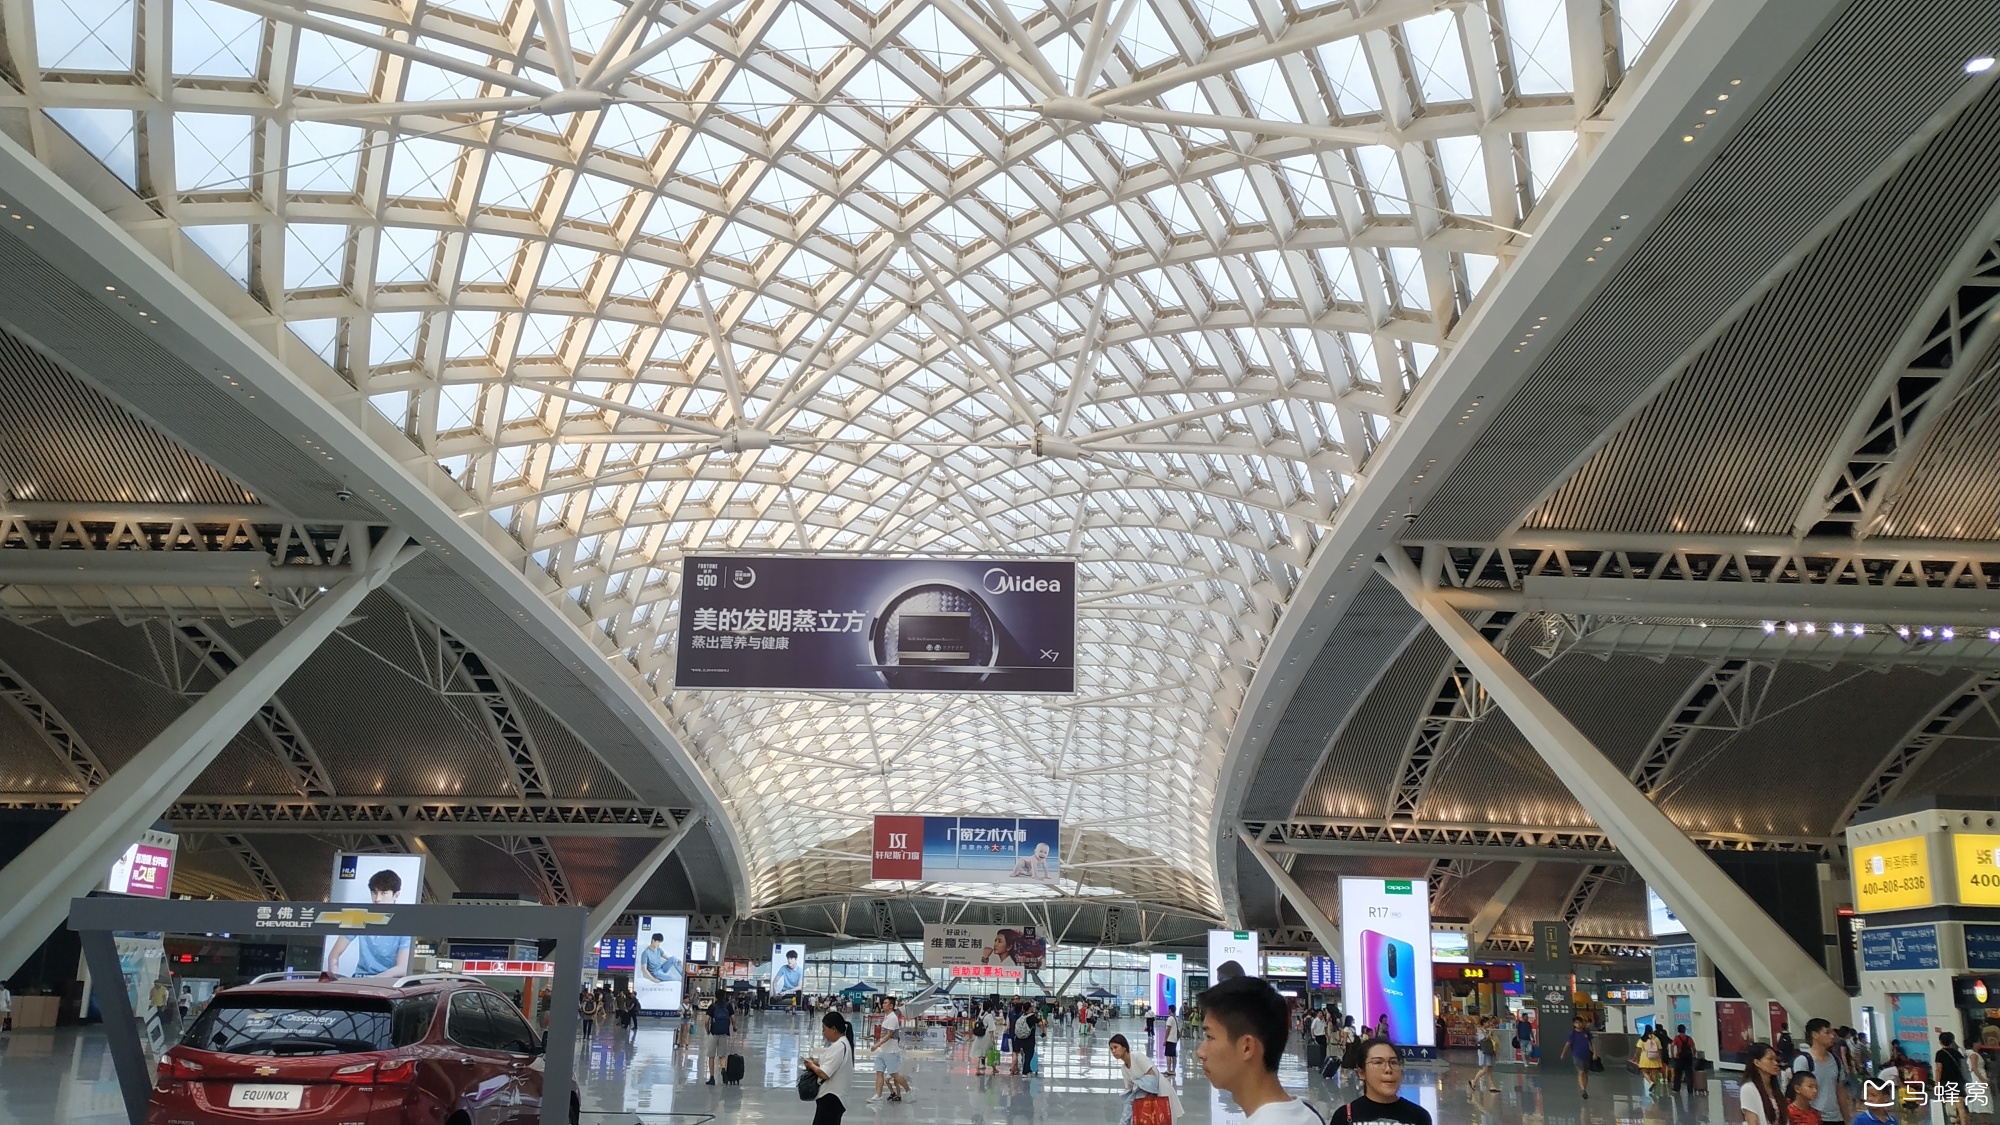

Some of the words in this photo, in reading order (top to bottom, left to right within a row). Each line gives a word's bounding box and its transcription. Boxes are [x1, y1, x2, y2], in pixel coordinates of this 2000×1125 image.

[696, 574, 718, 588] 500
[988, 571, 1061, 594] Midea
[693, 607, 867, 633] 美的发明蒸立方
[691, 635, 789, 650] 蒸出营养与健康
[1040, 648, 1060, 663] X7
[946, 827, 1027, 842] 门窗艺术大师
[1863, 876, 1926, 895] 400-808-8336
[257, 906, 315, 920] 雪佛兰
[1368, 906, 1389, 918] R17
[256, 920, 314, 928] CHEVROLET
[931, 938, 983, 949] 维意定制
[1224, 946, 1236, 954] R17
[952, 967, 1004, 977] 自助取票机
[848, 991, 862, 999] 出口
[1383, 987, 1404, 996] oppo
[285, 1014, 336, 1025] Discovery
[242, 1090, 289, 1101] EQUINOX
